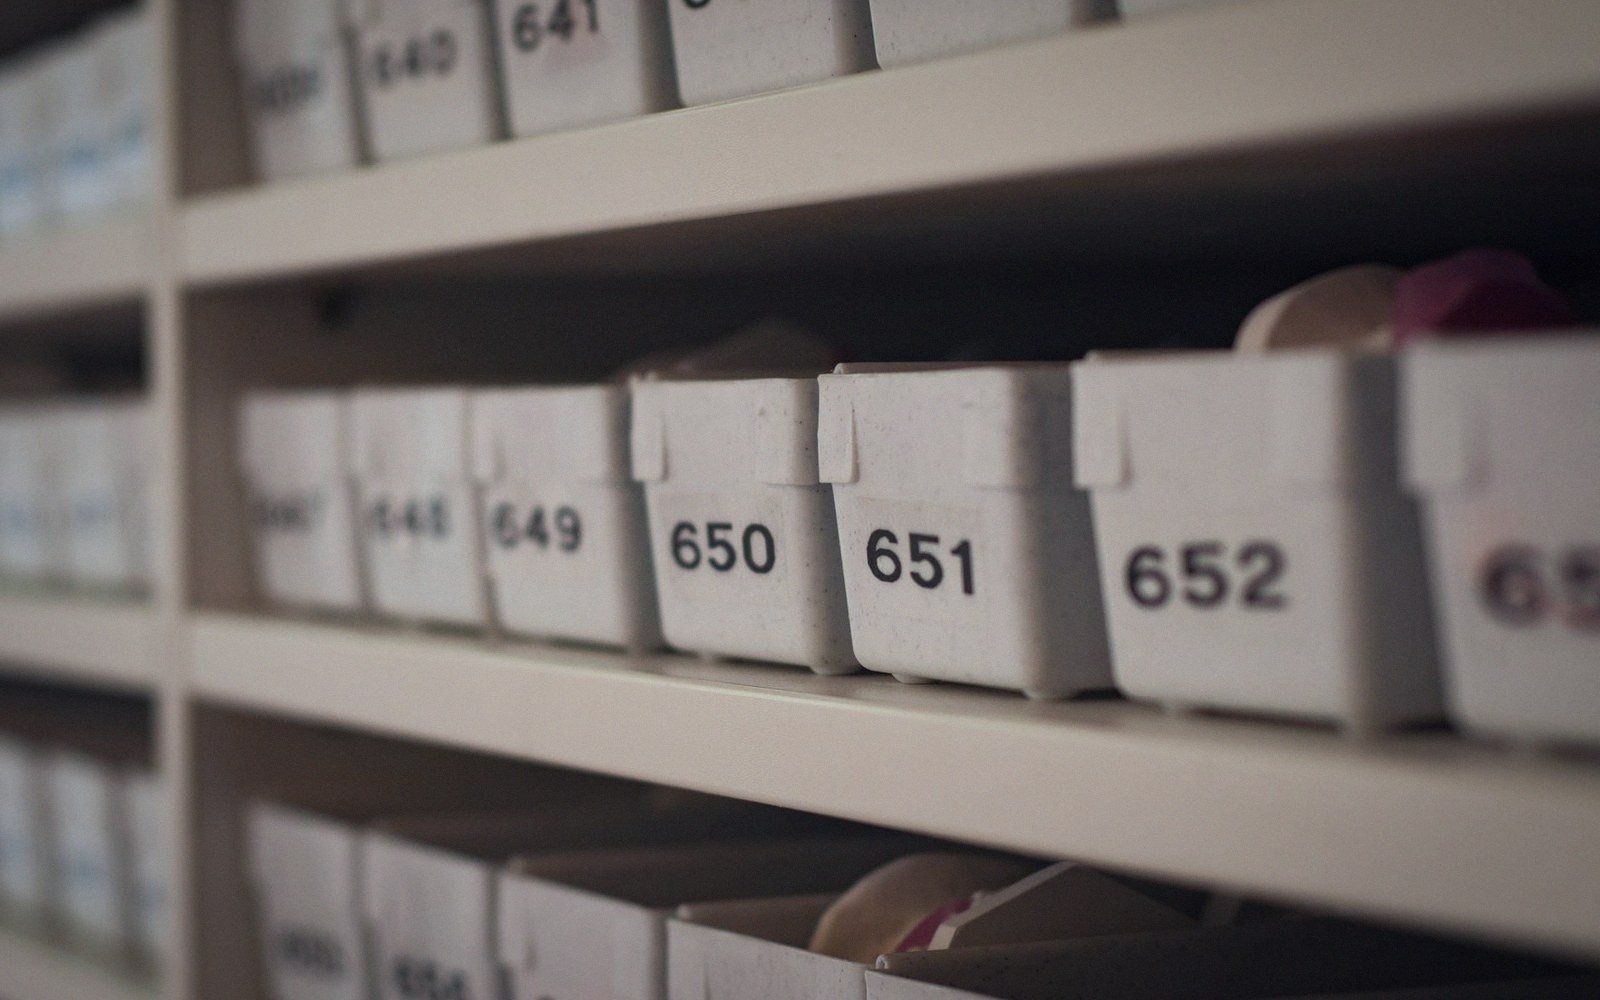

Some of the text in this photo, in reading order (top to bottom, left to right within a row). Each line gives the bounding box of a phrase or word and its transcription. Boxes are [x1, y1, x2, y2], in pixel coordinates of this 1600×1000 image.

[511, 0, 599, 52] 641
[491, 504, 584, 554] 649
[670, 519, 777, 575] 650
[866, 528, 975, 596] 651
[1123, 540, 1289, 611] 652
